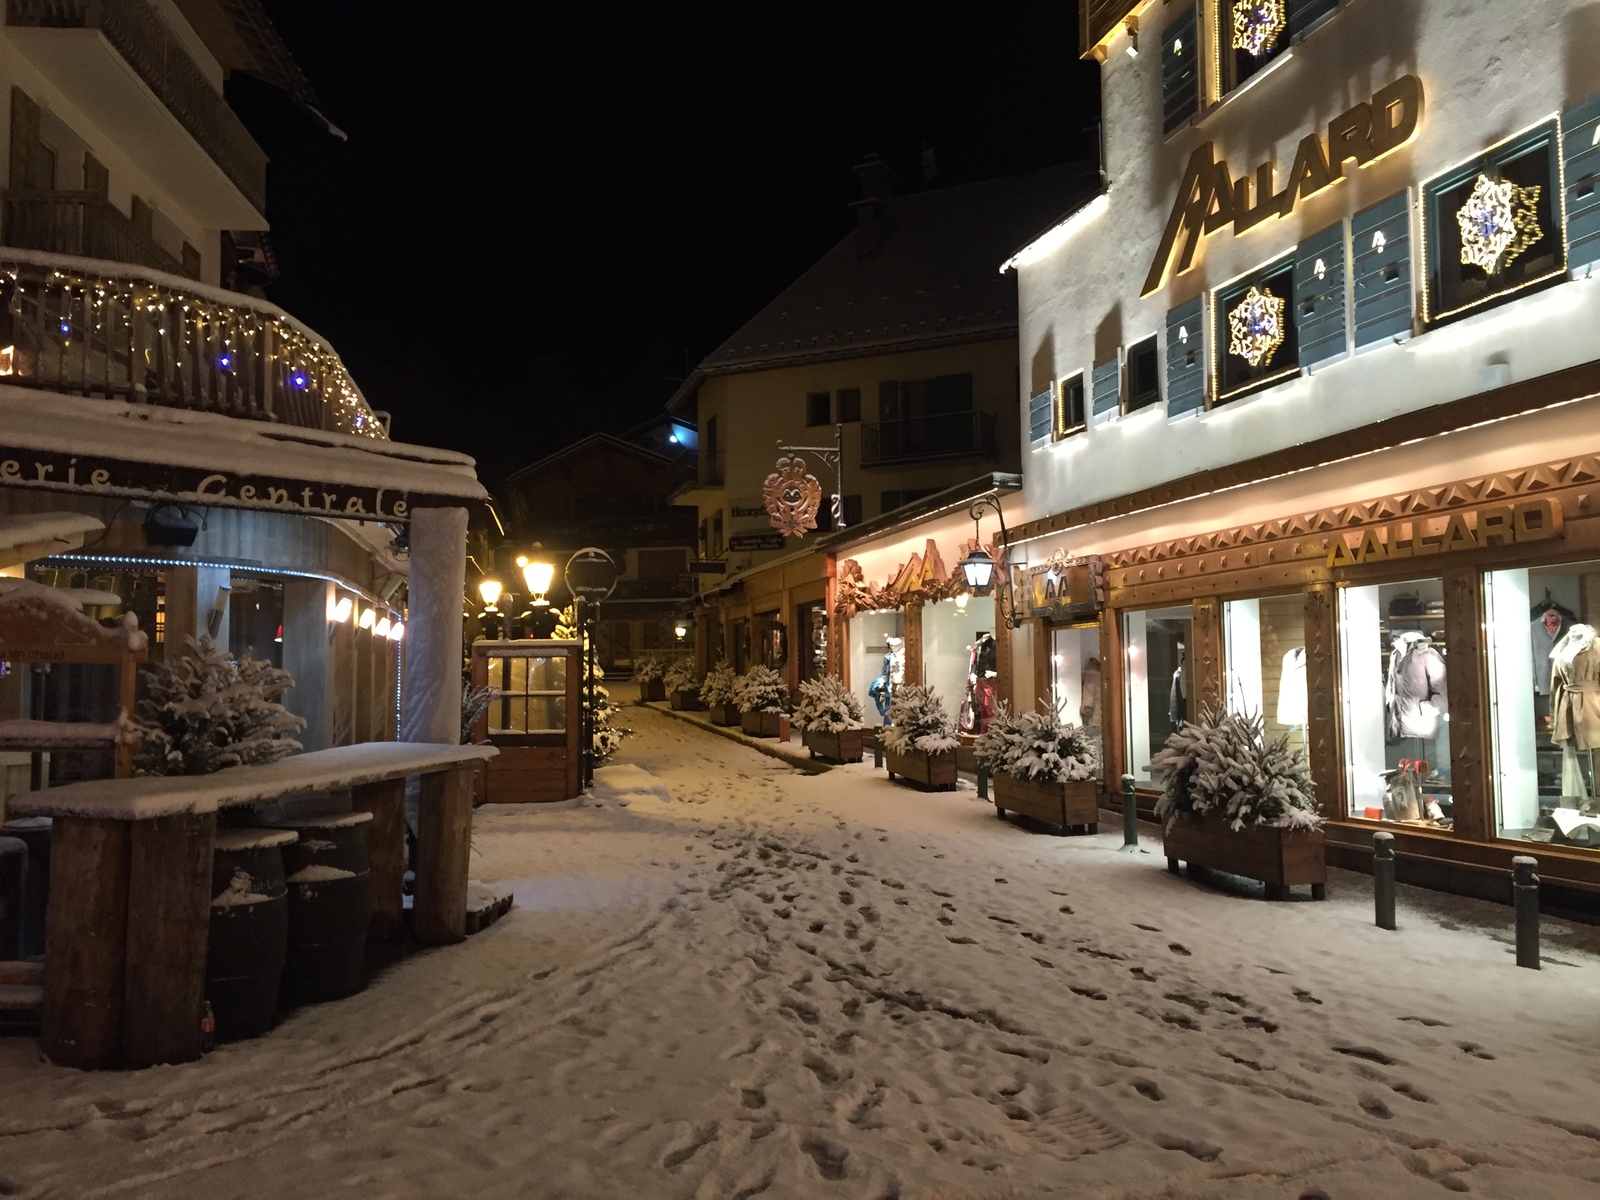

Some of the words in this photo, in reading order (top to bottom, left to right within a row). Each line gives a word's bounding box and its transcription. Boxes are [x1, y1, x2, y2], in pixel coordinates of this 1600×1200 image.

[196, 473, 409, 517] Centrale
[1326, 498, 1560, 569] AALLARD
[29, 650, 64, 660] chaud
